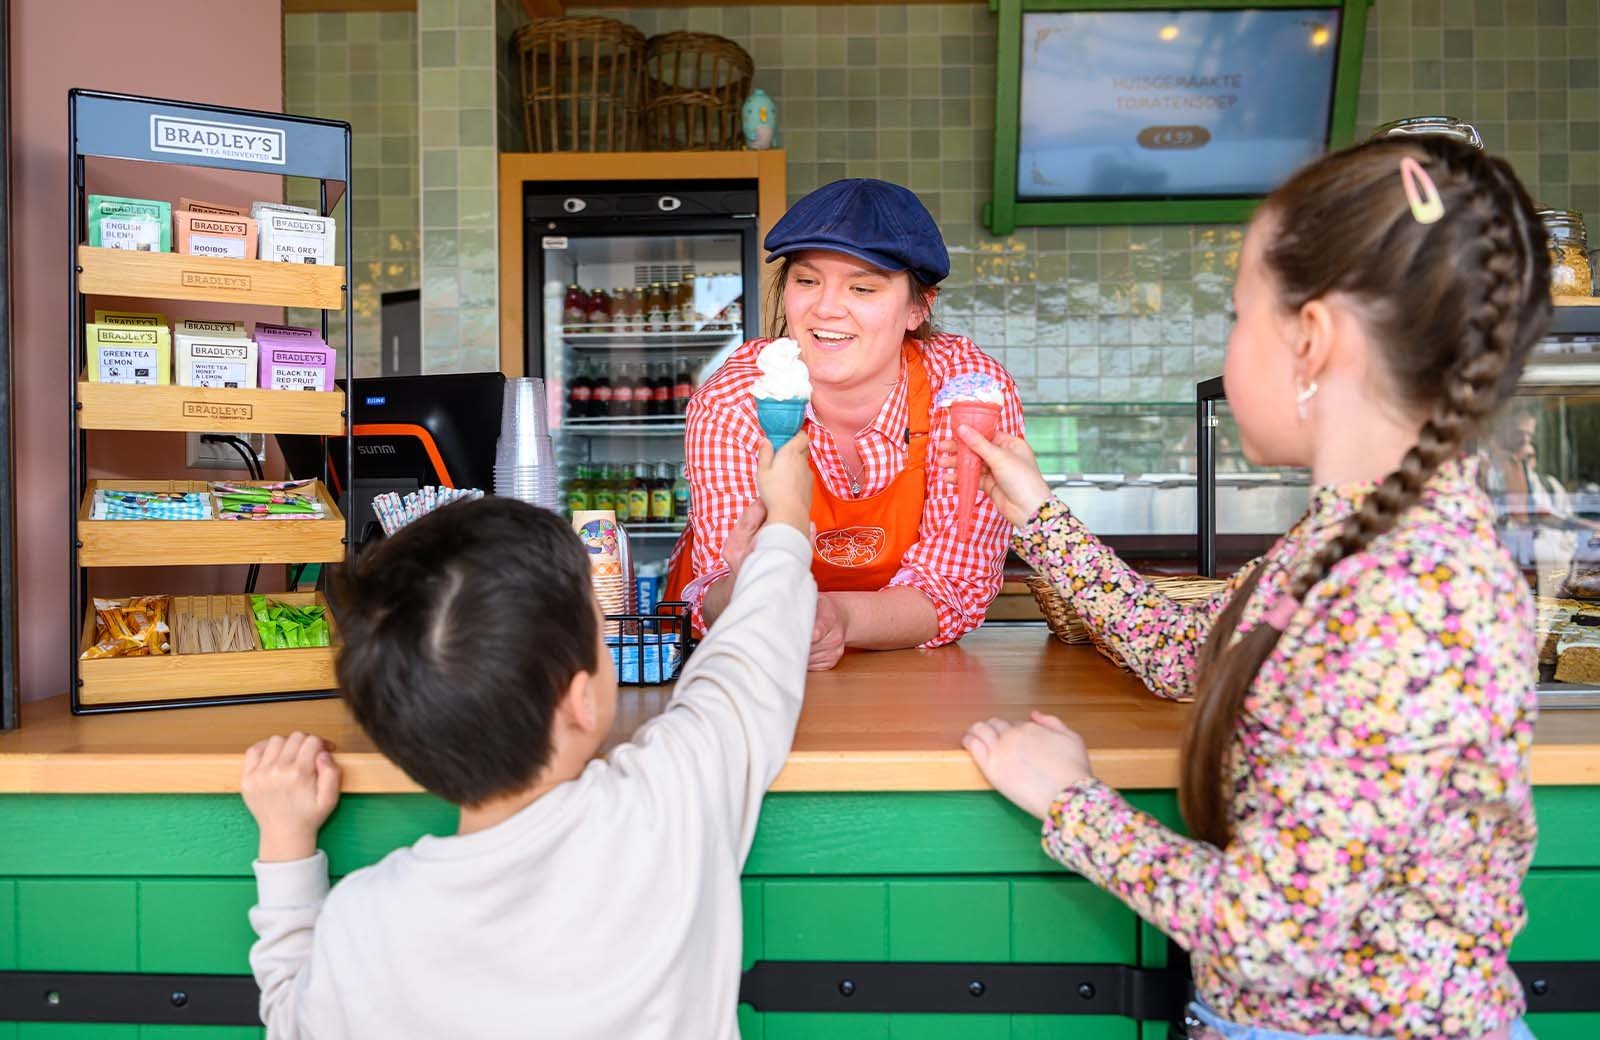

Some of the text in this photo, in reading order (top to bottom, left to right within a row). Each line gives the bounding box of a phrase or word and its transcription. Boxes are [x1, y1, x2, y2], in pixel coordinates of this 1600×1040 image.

[164, 126, 272, 152] BRADLEY'S
[205, 147, 270, 160] TEA REINVENTED
[106, 222, 142, 232] ENGLISH
[194, 221, 243, 233] BRADLEY'S
[276, 219, 322, 231] BRADLEY'S
[106, 231, 134, 239] BLEND
[194, 245, 228, 254] ROOIBOS
[276, 245, 318, 255] EARL GREY
[187, 274, 248, 287] BRADLEY'S
[188, 322, 232, 332] BRADLEY'S
[102, 331, 153, 341] BRADLEY'S
[103, 350, 131, 358] GREEN
[195, 346, 243, 356] BRADLEY'S
[276, 353, 322, 362] BRADLEY'S
[276, 369, 301, 377] BLACK
[188, 405, 248, 416] BRADLEY'S
